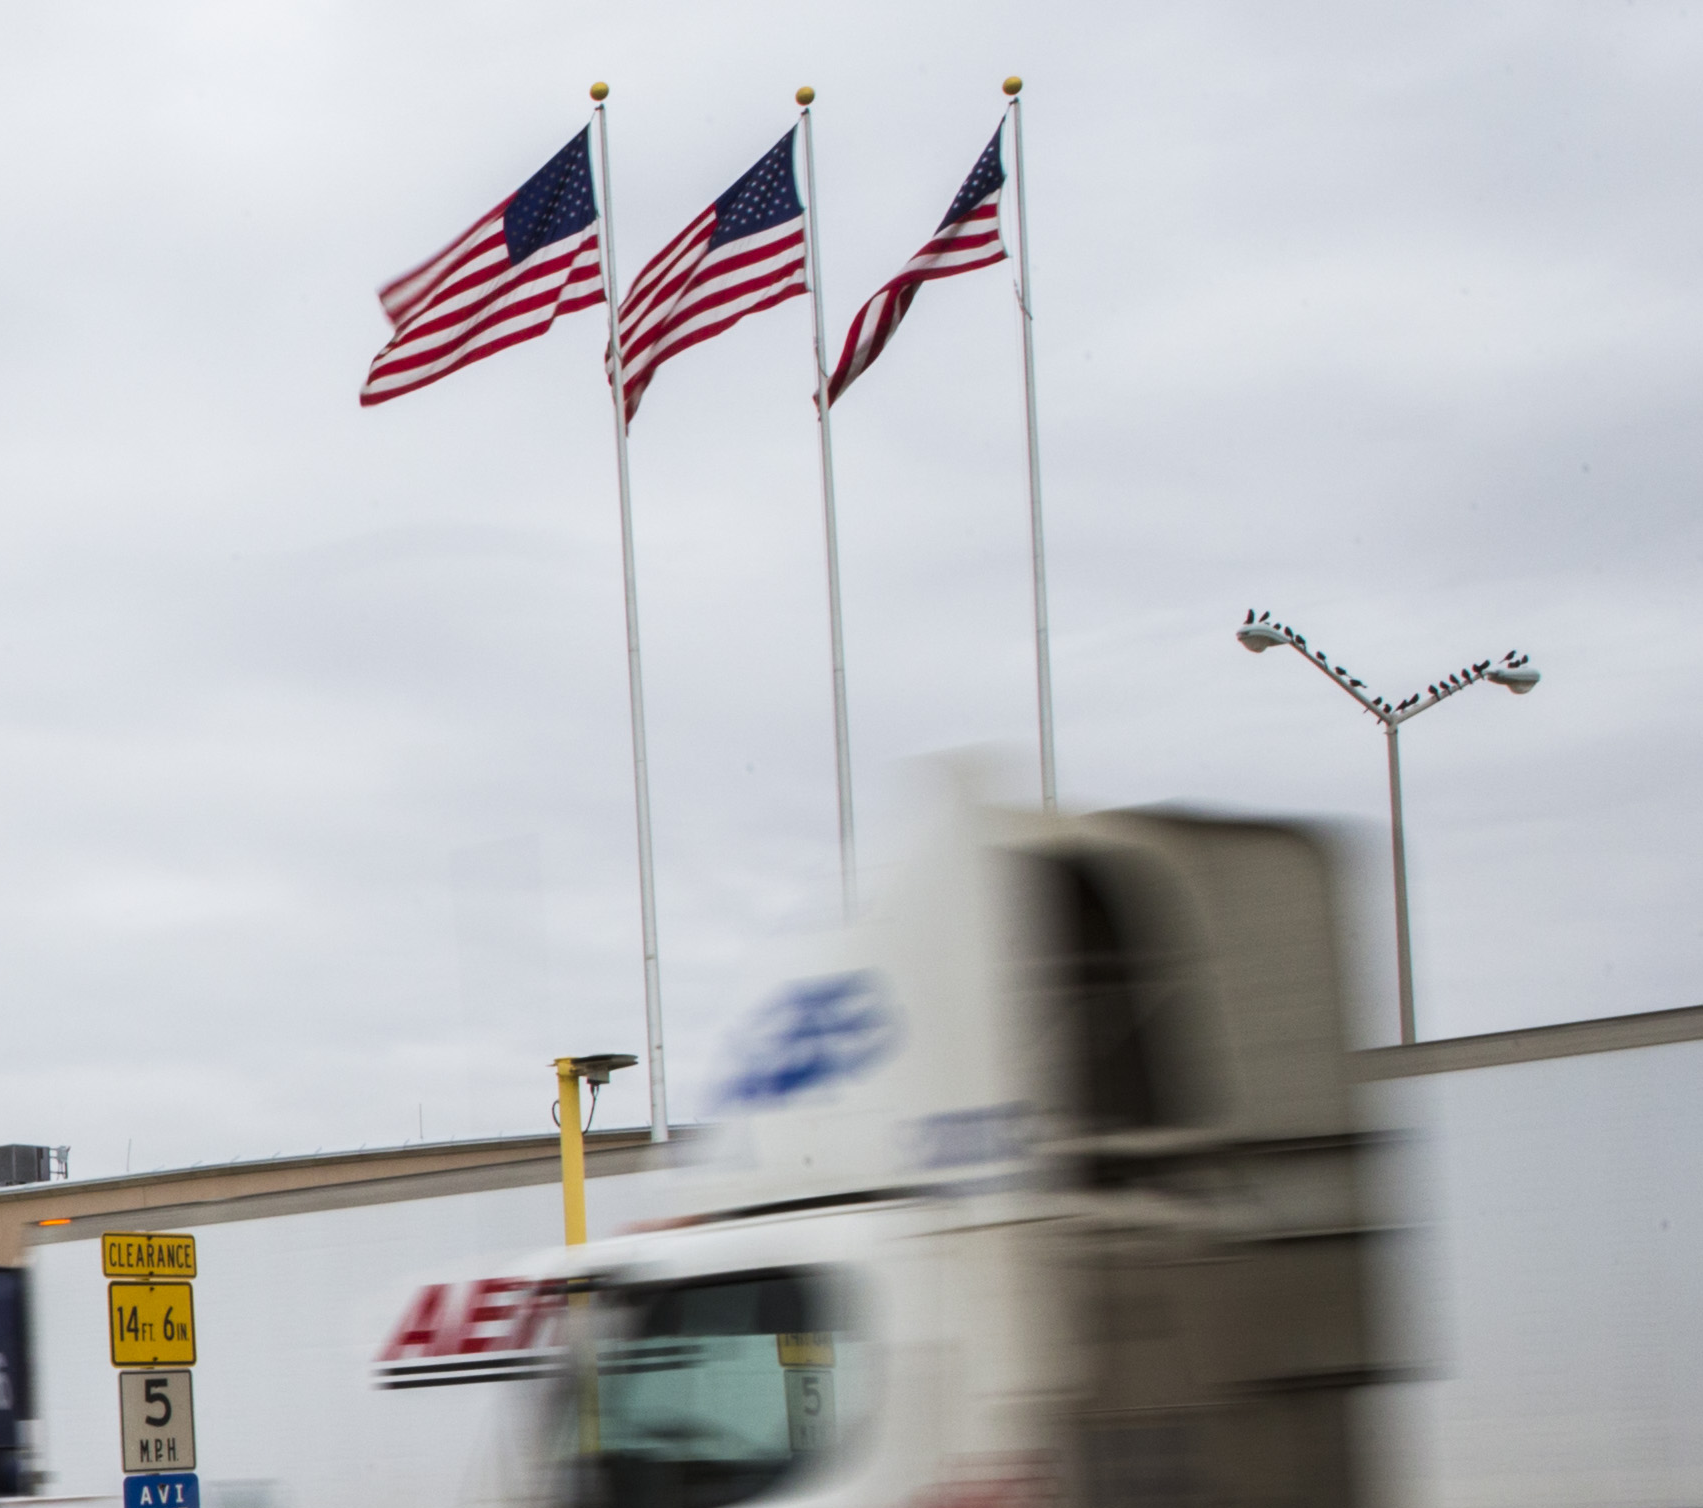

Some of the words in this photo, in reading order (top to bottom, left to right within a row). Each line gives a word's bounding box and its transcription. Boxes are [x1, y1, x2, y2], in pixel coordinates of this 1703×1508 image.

[109, 1242, 192, 1268] CLEARANCE
[116, 1305, 139, 1342] 14
[144, 1378, 172, 1427] 5
[140, 1437, 179, 1462] M.P.H.
